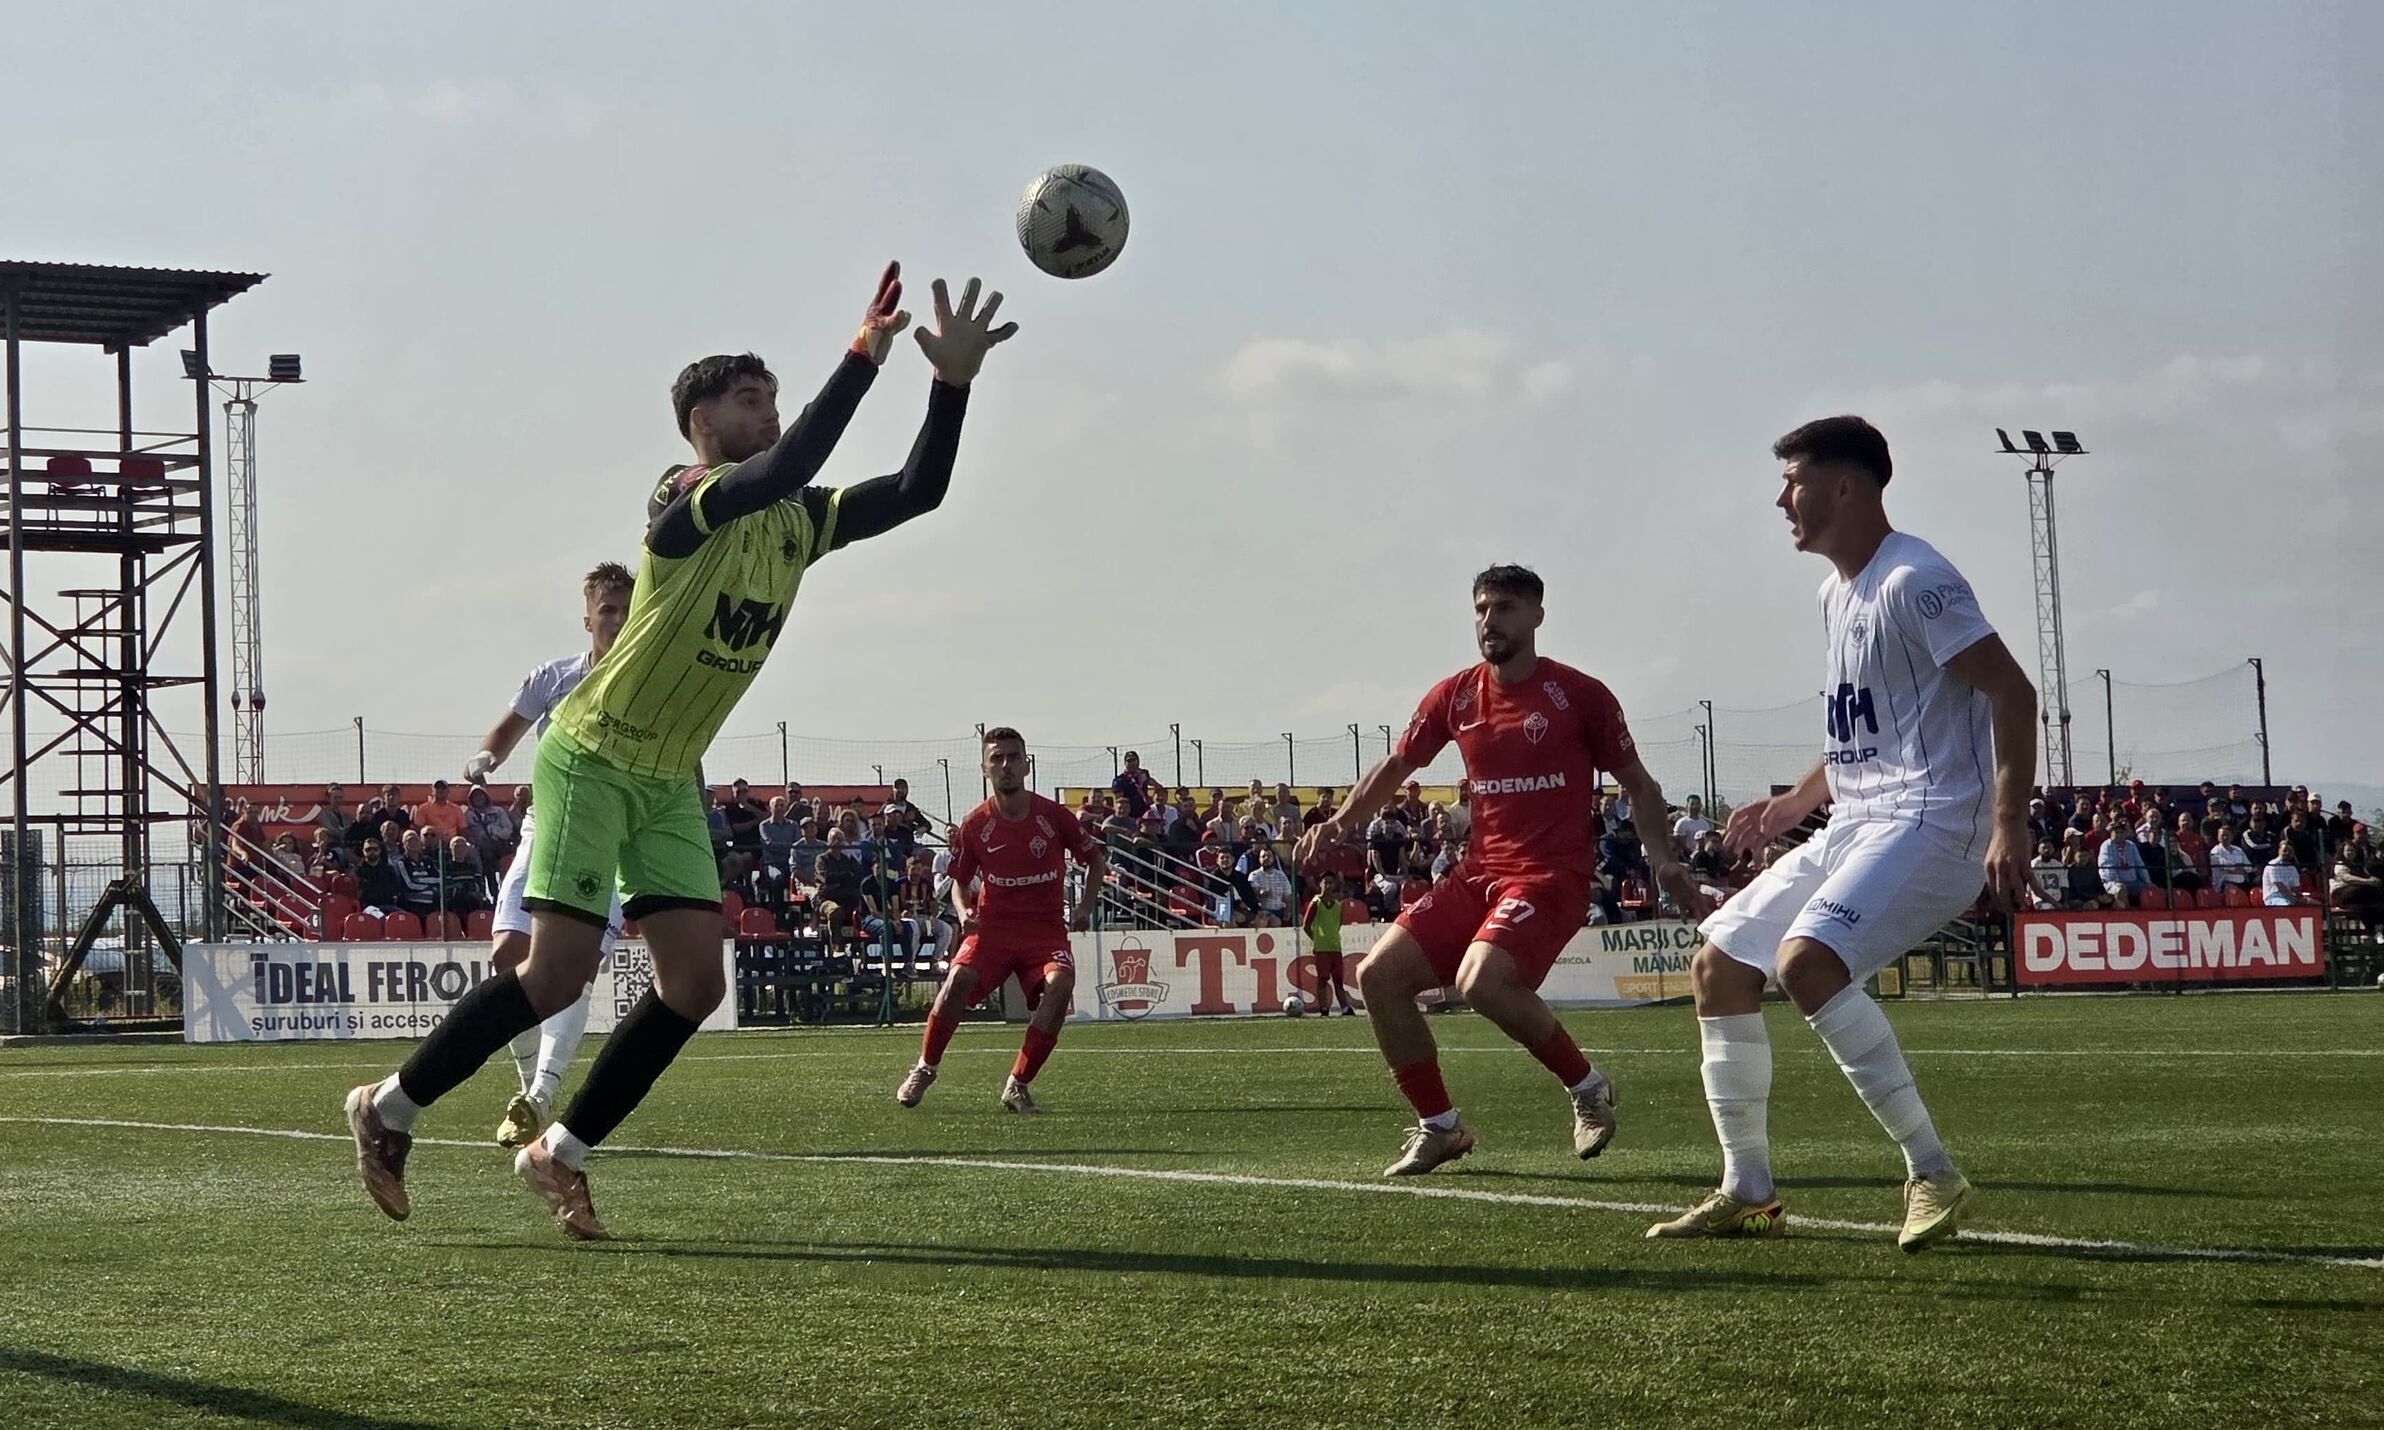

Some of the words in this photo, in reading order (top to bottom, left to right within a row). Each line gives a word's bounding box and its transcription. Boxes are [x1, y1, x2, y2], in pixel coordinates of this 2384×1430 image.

[1470, 772, 1566, 794] DEDEMAN
[988, 869, 1057, 887] DEDEMAN
[1493, 898, 1535, 924] 27
[1673, 927, 1706, 949] CA
[2024, 917, 2315, 972] DEDEMAN
[1633, 951, 1694, 974] MĂNÂN
[251, 1012, 340, 1036] șuruburi
[347, 1011, 364, 1036] și
[371, 1014, 443, 1029] acceso
